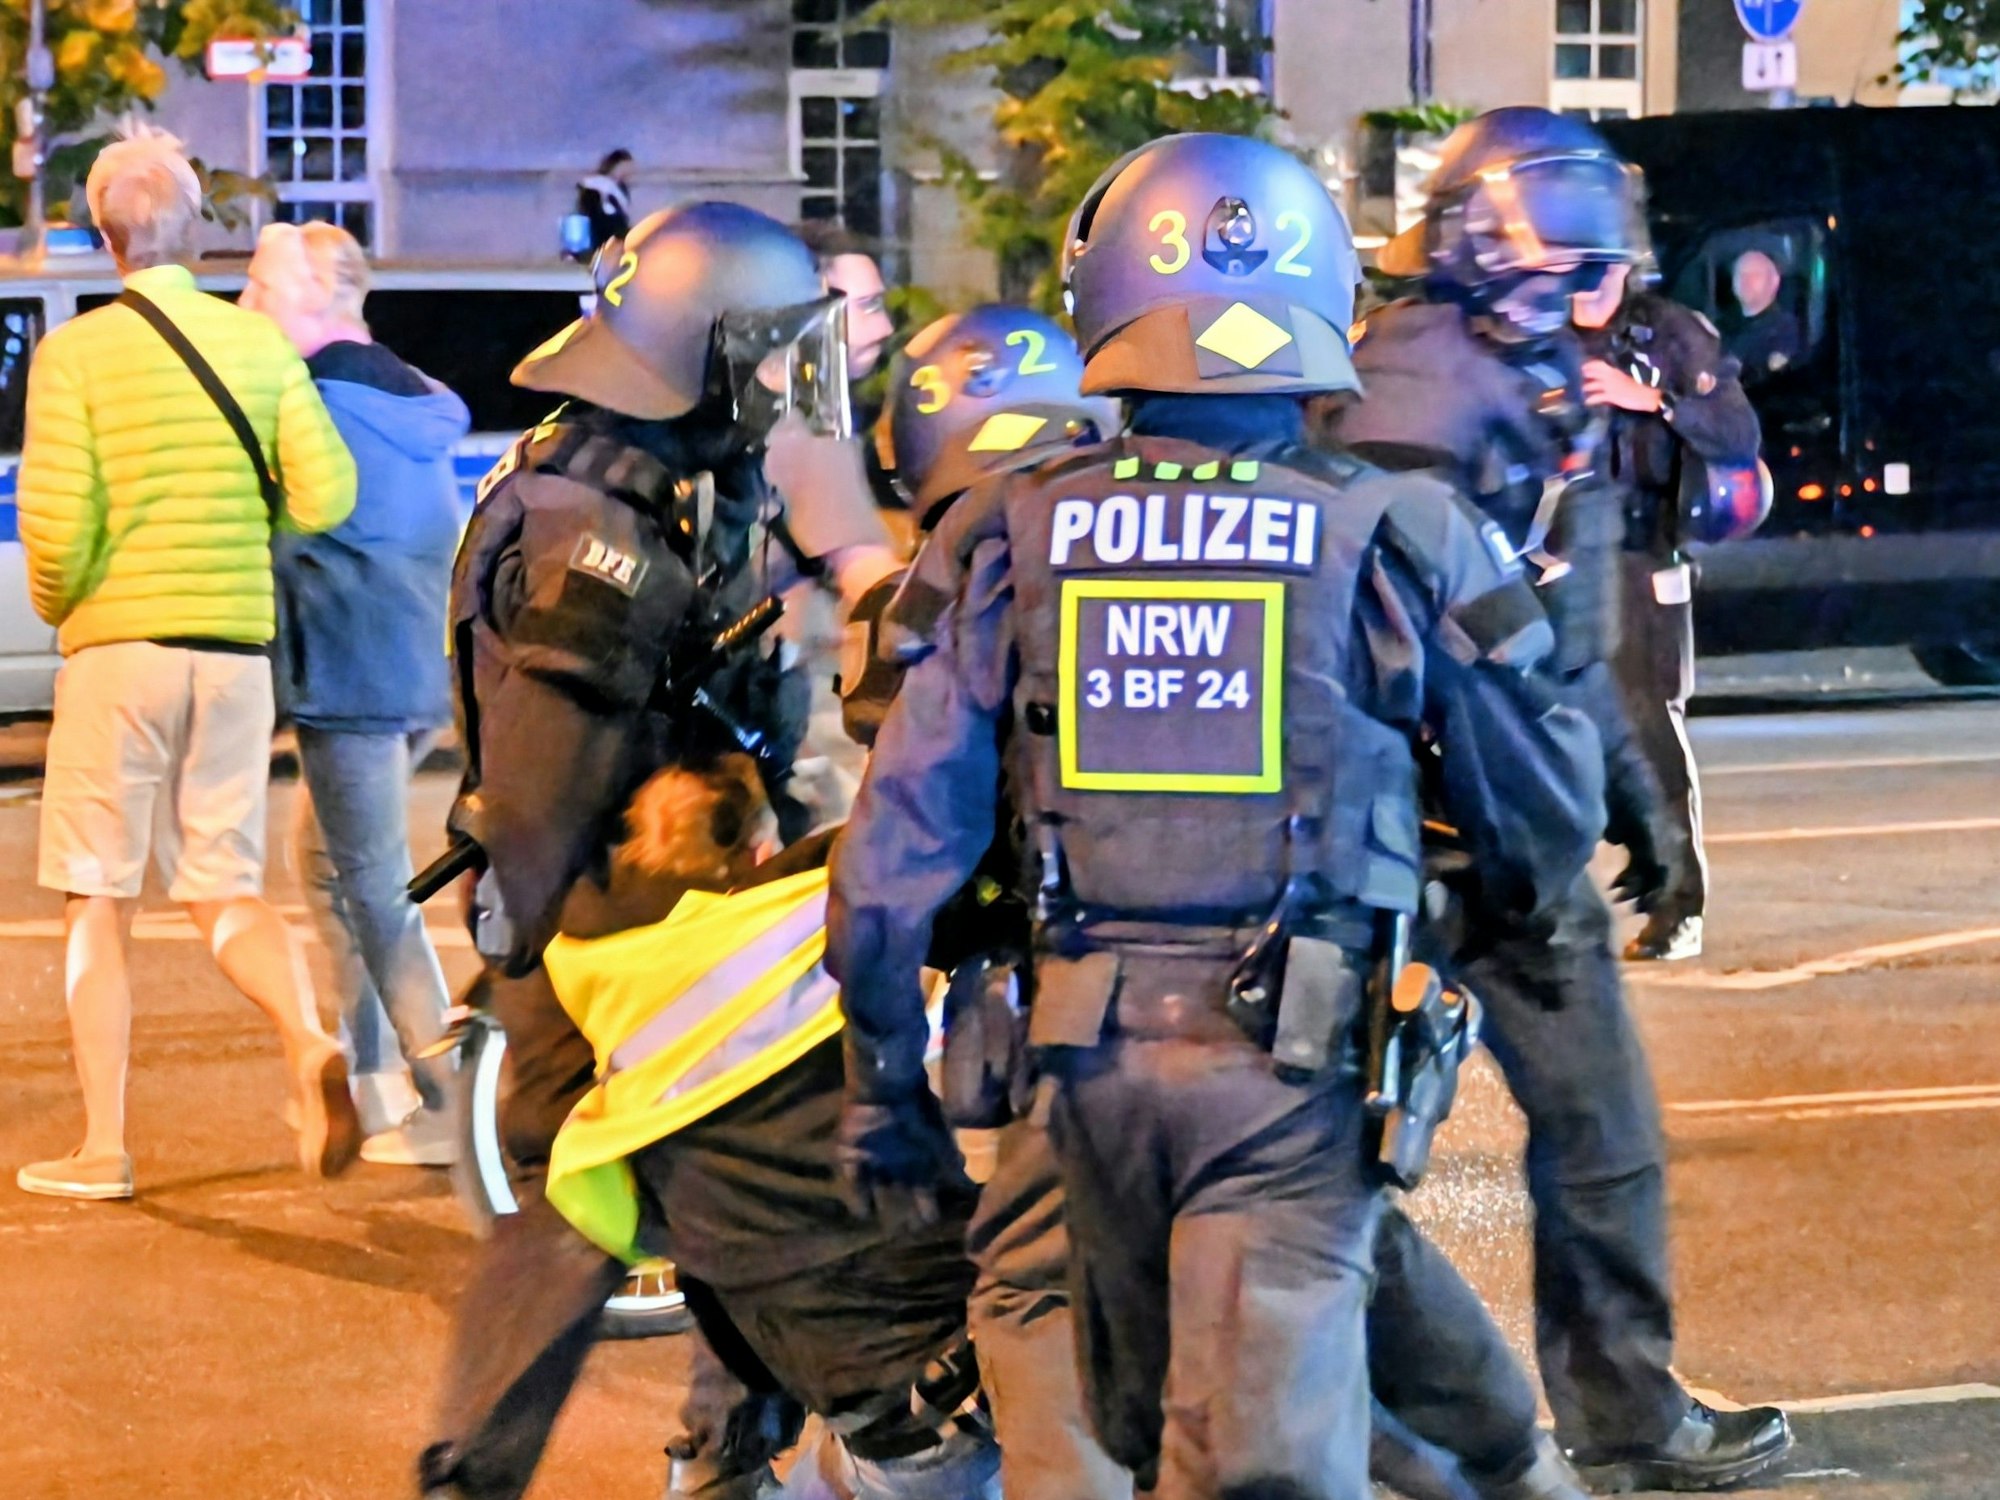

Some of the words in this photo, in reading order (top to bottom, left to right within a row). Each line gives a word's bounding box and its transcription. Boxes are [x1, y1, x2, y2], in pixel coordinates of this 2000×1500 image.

[1149, 210, 1190, 275] 3
[1274, 210, 1312, 277] 2
[604, 251, 638, 307] 2
[910, 364, 951, 414] 3
[1005, 329, 1057, 376] 2
[1049, 494, 1317, 565] POLIZEI
[1107, 605, 1231, 656] NRW
[1086, 669, 1112, 708] 3
[1124, 669, 1185, 708] BF
[1195, 669, 1250, 709] 24
